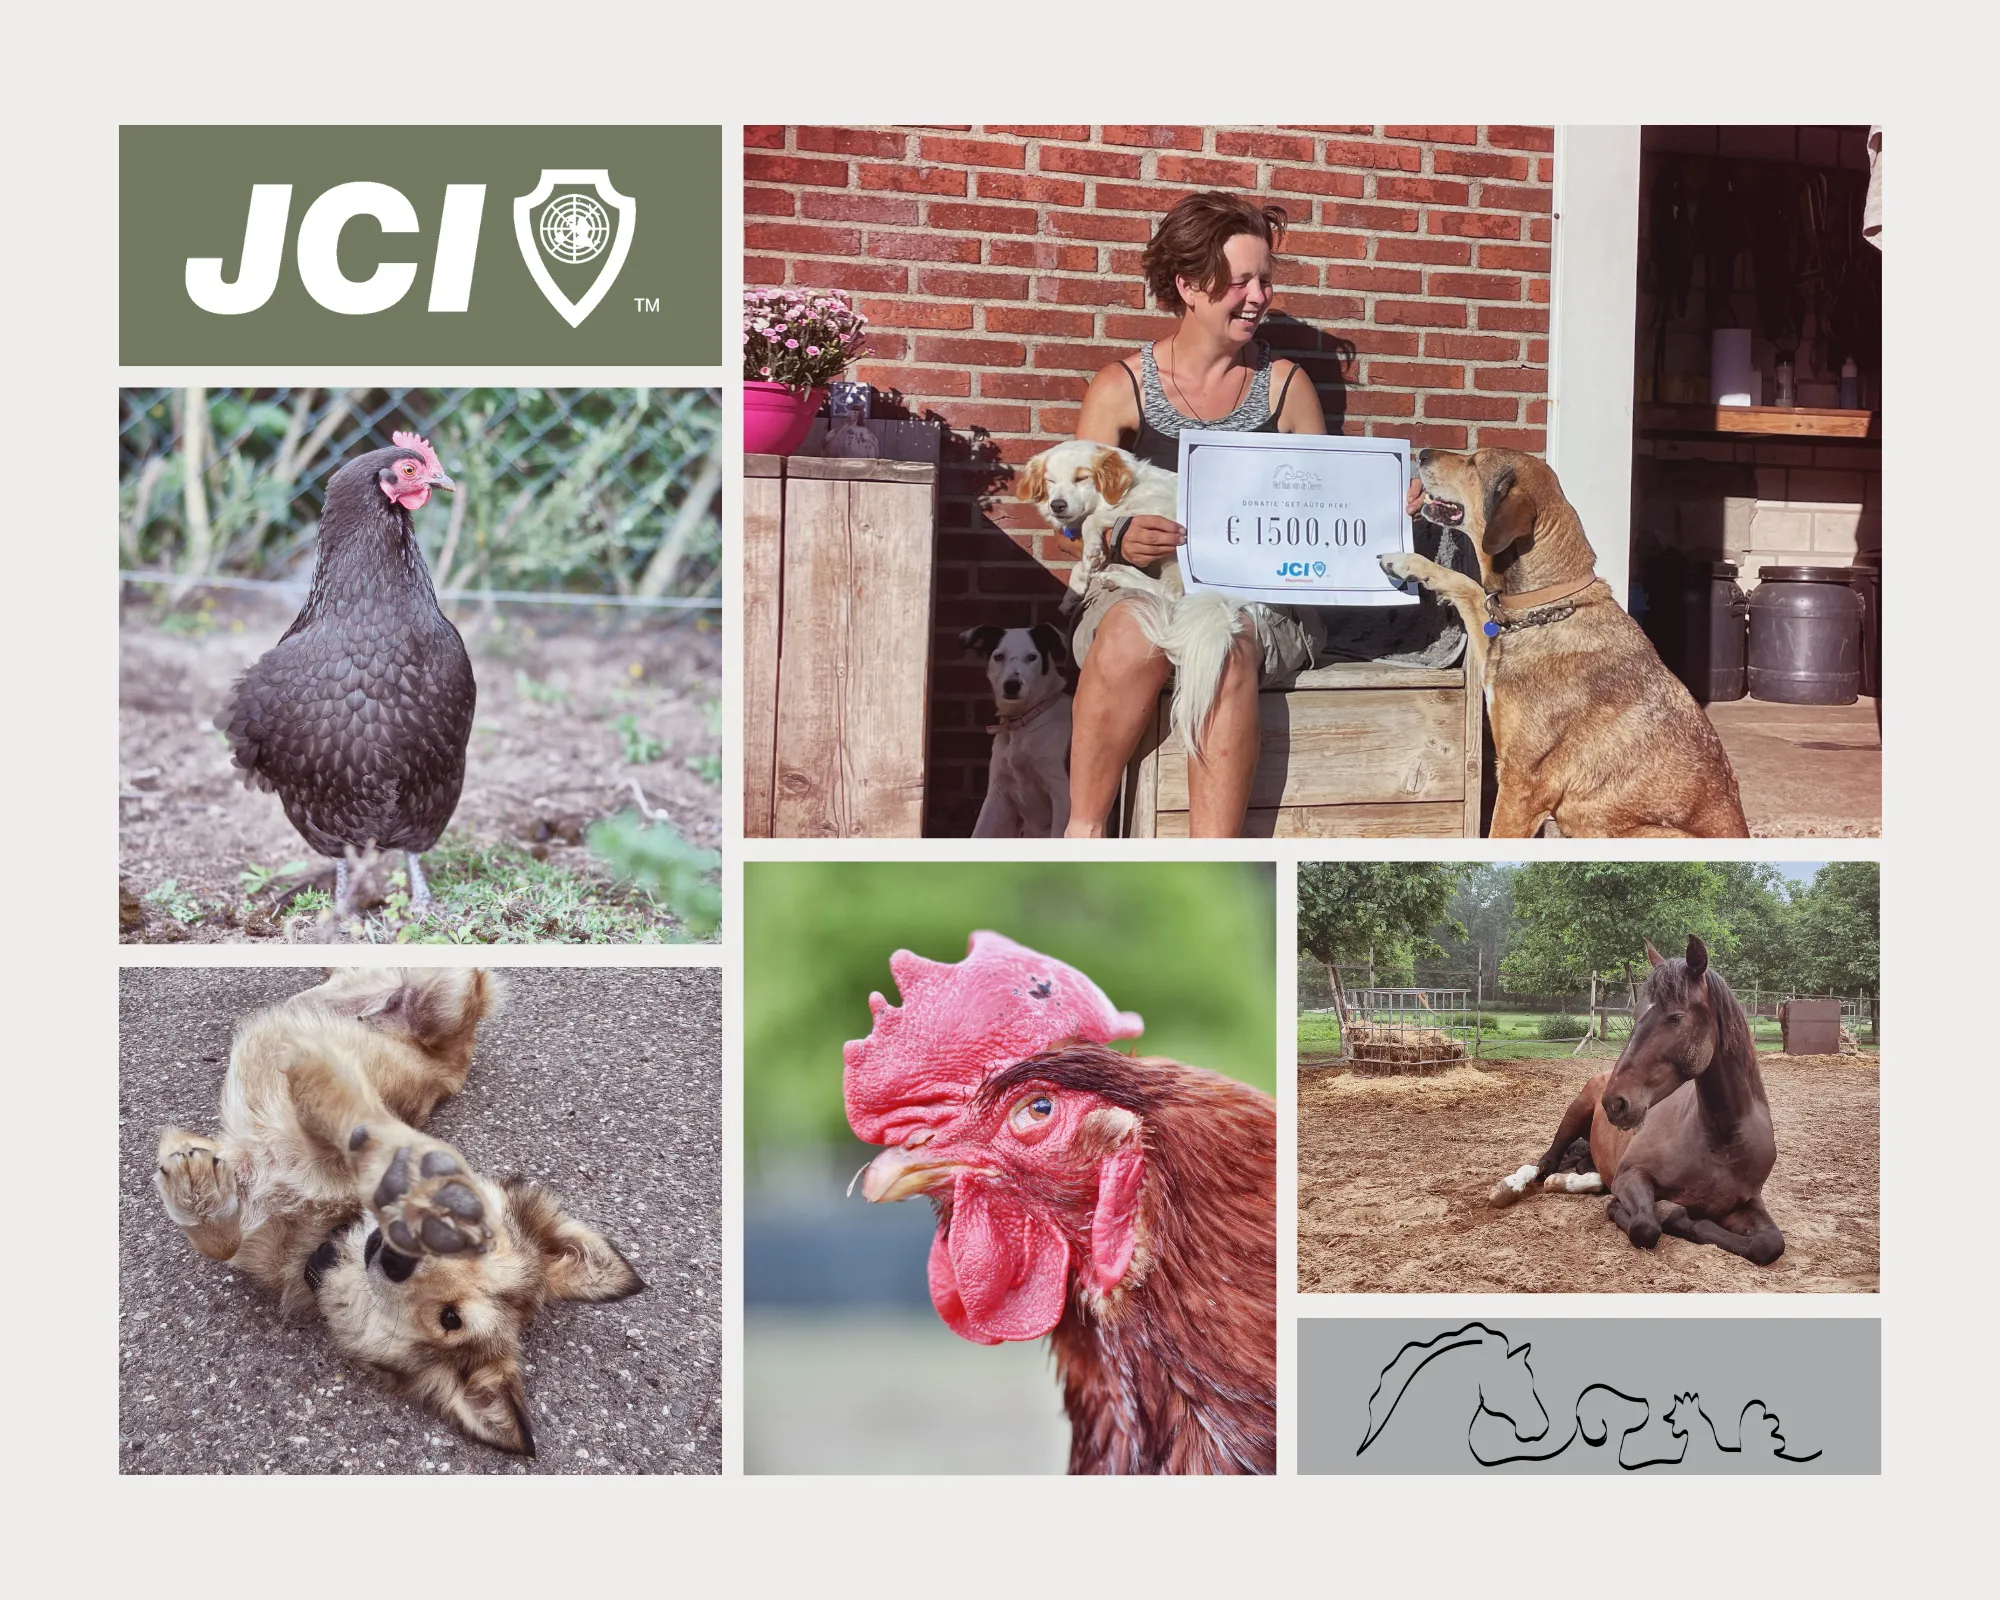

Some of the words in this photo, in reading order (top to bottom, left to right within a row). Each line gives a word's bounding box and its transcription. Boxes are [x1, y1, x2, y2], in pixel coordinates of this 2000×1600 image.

[1226, 515, 1240, 545] €
[1255, 516, 1366, 548] 1500,00
[1276, 562, 1310, 576] JCI
